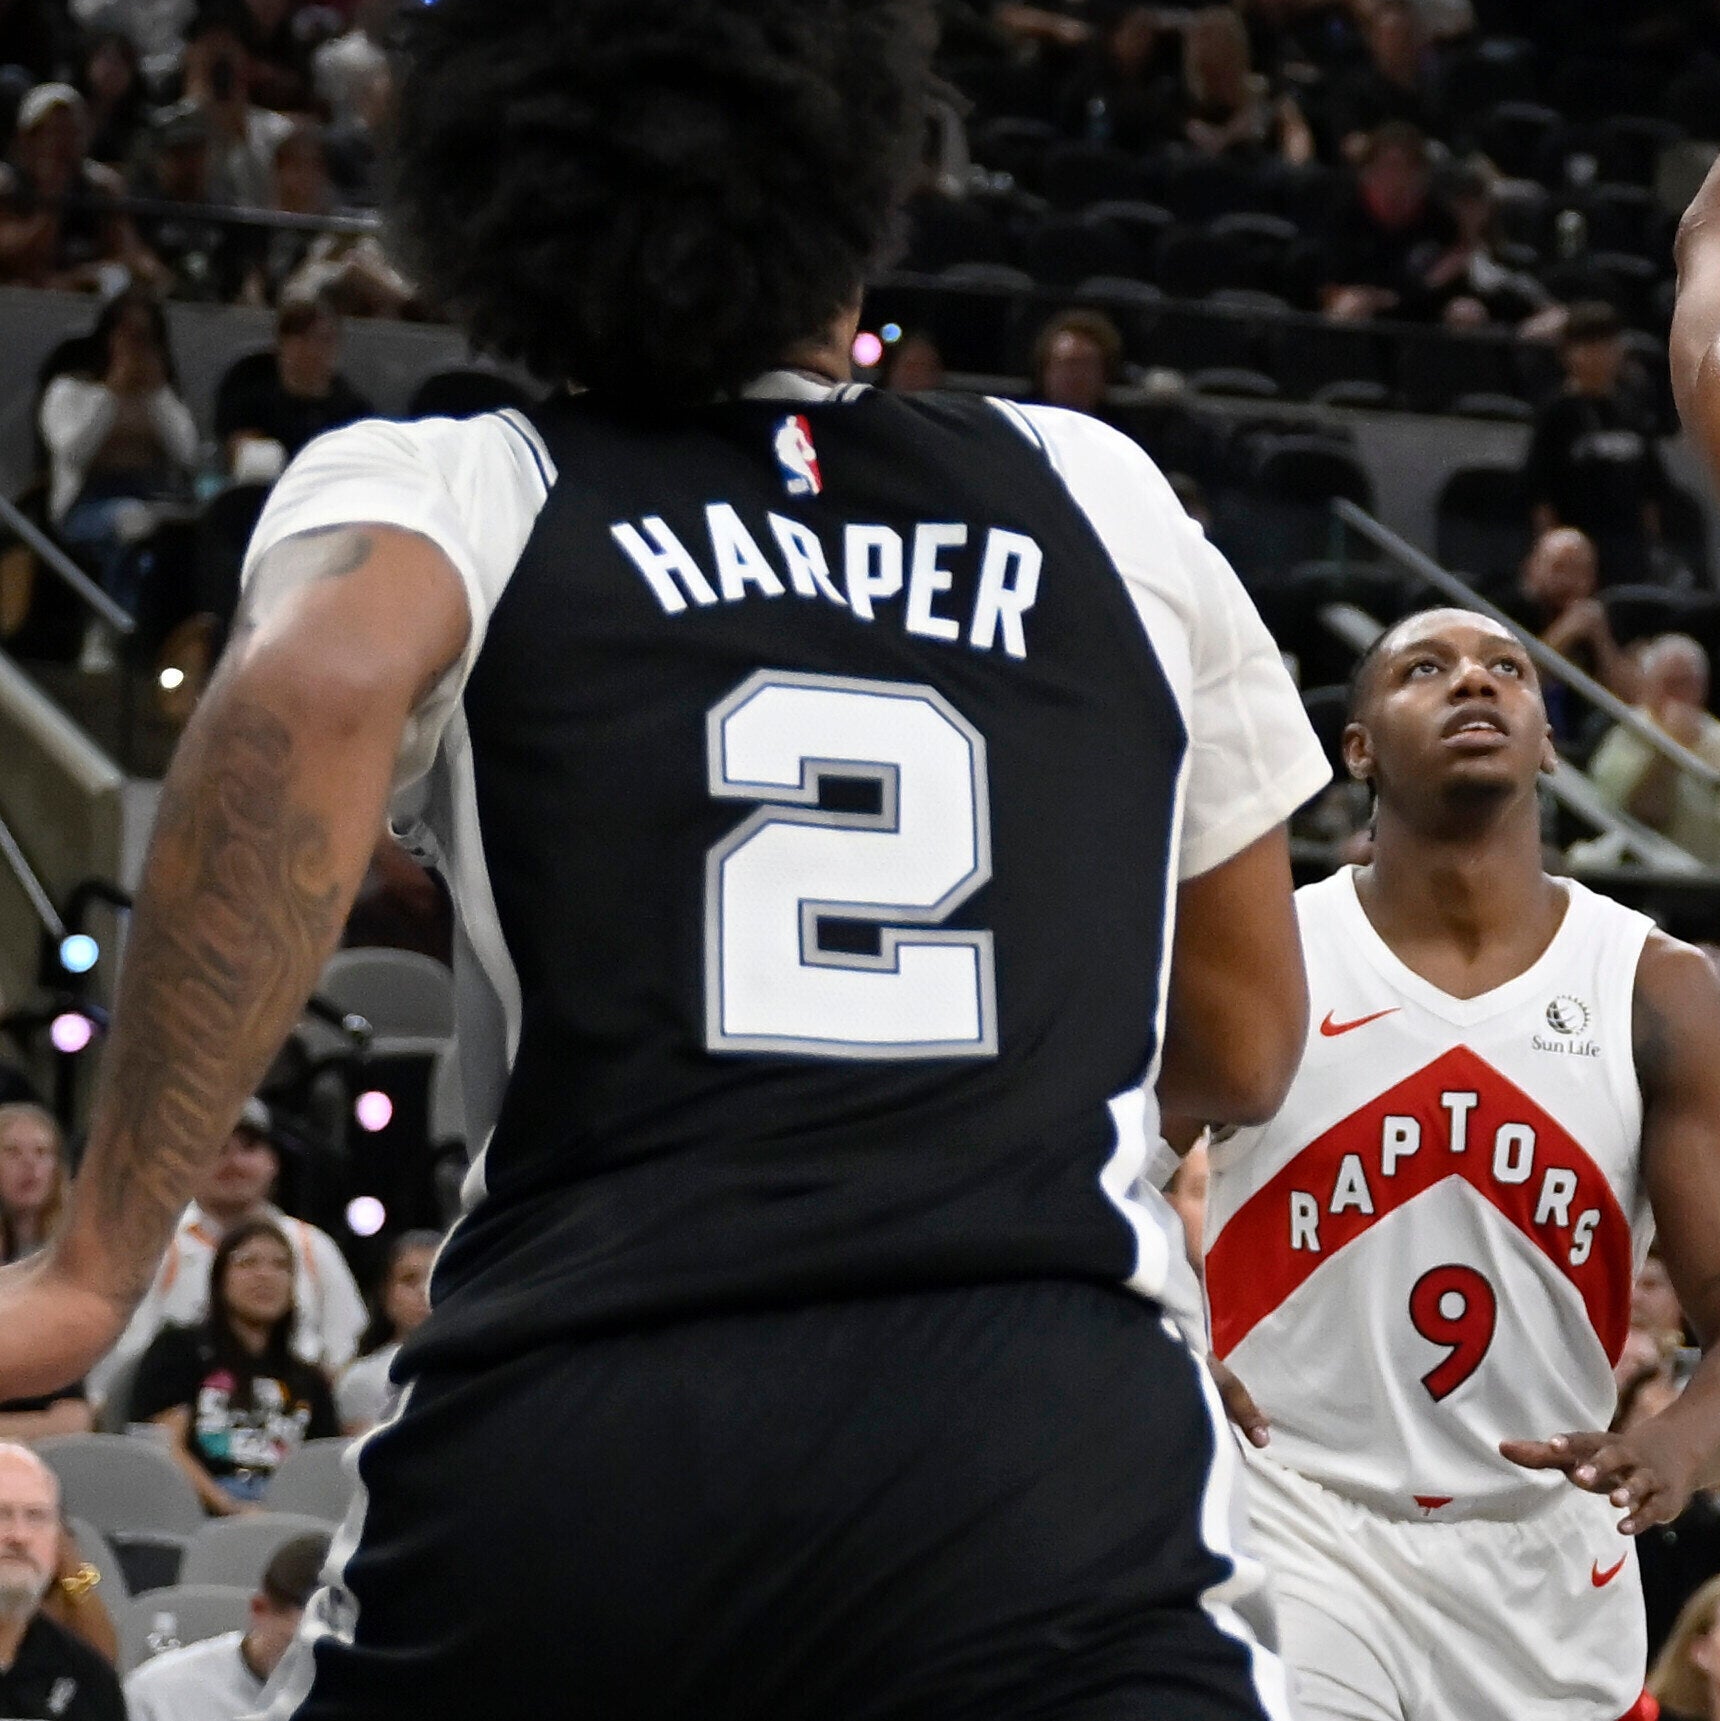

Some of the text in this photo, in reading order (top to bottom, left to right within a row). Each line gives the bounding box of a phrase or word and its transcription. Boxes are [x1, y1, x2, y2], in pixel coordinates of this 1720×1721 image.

[609, 501, 1044, 660] HARPER
[705, 668, 998, 1058] 2
[1531, 1034, 1601, 1057] Sun Life
[1289, 1090, 1601, 1267] RAPTORS
[1408, 1264, 1497, 1403] 9
